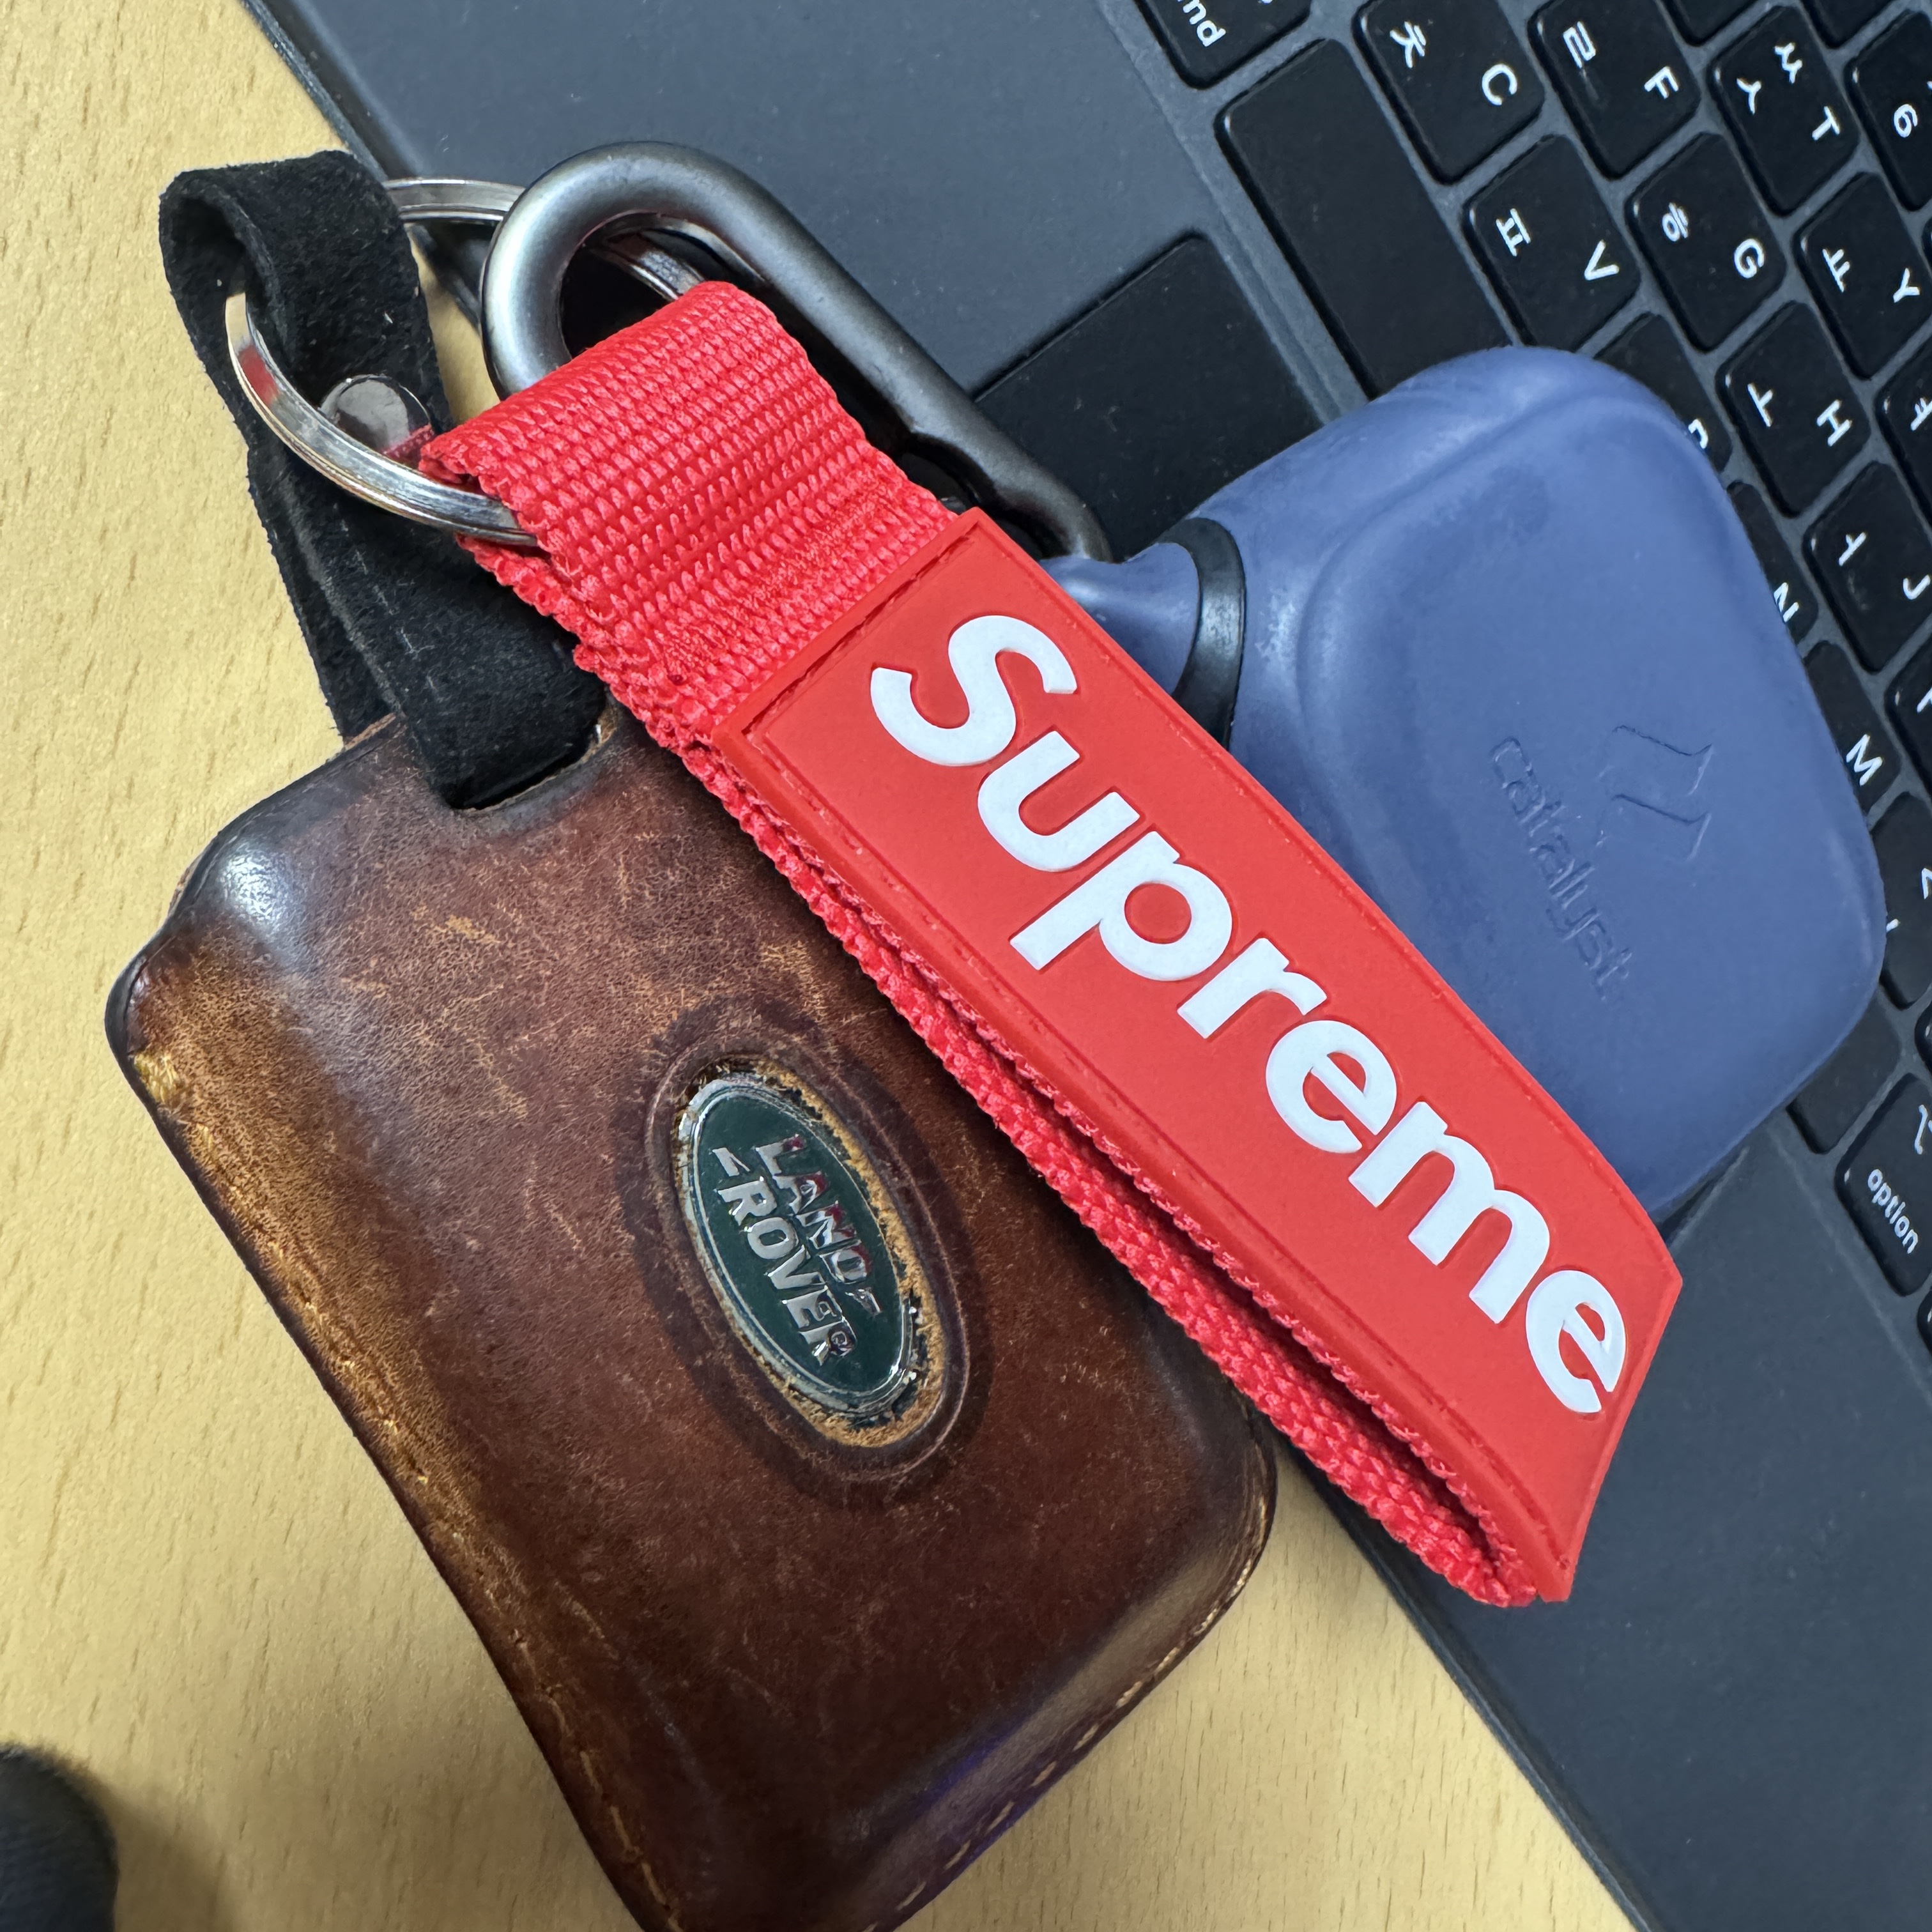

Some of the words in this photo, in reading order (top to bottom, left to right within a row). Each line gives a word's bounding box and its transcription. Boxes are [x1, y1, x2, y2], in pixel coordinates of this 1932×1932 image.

[1563, 21, 1596, 68] ㄹ
[1482, 63, 1518, 105] C
[1644, 66, 1679, 98] F
[1812, 106, 1840, 140] T
[1894, 103, 1918, 137] 6
[1496, 208, 1531, 257] ㅍ
[1662, 203, 1689, 241] ㅎ
[1584, 240, 1620, 280] V
[1734, 238, 1765, 279] G
[1893, 268, 1920, 303] Y
[1816, 400, 1852, 447] H
[1774, 582, 1799, 622] N
[1903, 574, 1931, 600] J
[1846, 733, 1883, 786] M
[1489, 736, 1633, 1002] catalyst
[870, 615, 1627, 1414] Supreme
[1867, 1169, 1919, 1254] option
[714, 1175, 857, 1366] ROVER
